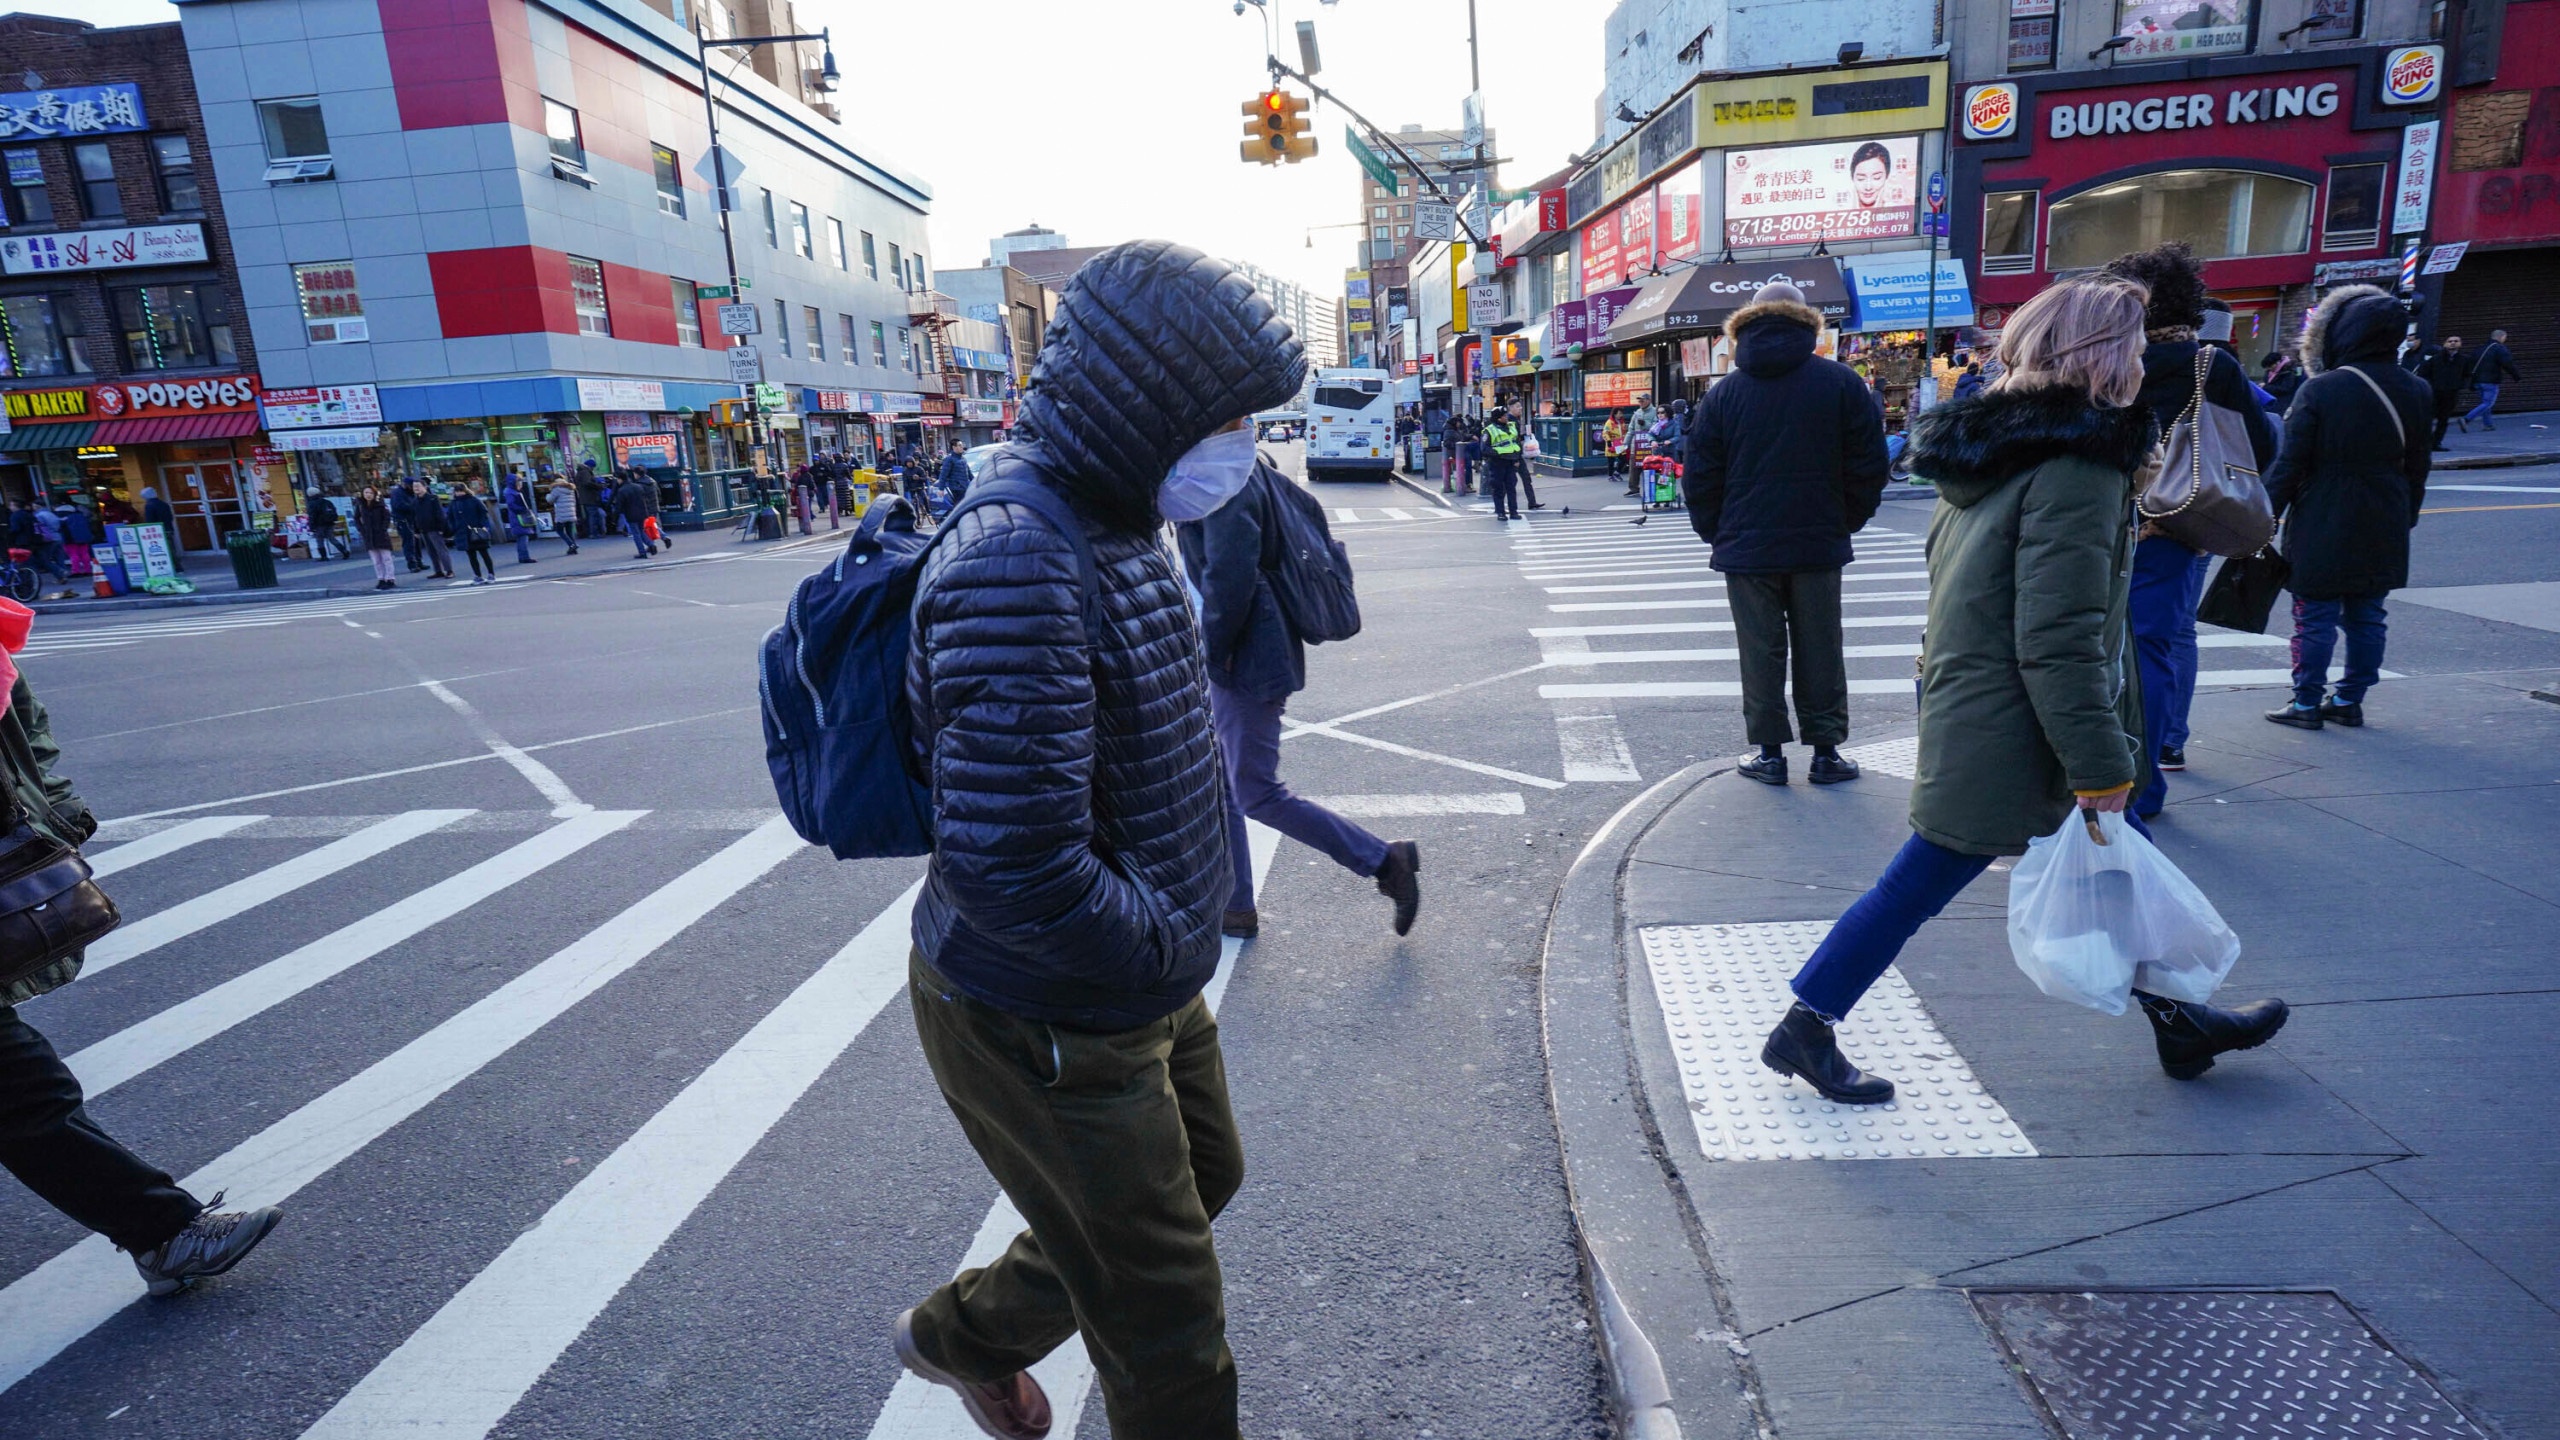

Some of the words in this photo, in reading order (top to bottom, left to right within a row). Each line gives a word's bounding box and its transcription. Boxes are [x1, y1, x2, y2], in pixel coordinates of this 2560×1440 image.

[2216, 32, 2243, 46] BLOCK
[2391, 55, 2434, 78] BURGER
[2392, 65, 2434, 91] KING
[1971, 93, 2009, 114] BURGER
[1972, 101, 2010, 126] KING
[2050, 93, 2214, 139] BURGER
[2226, 82, 2339, 124] KING
[1754, 169, 1814, 188] 常青医美
[1435, 206, 1454, 214] BLOCK
[1423, 213, 1434, 221] THE
[1436, 214, 1447, 222] BOX
[1739, 210, 1872, 235] 718-808-5758
[1739, 235, 1754, 245] Sky
[1756, 235, 1777, 244] View
[1779, 231, 1809, 241] Center
[704, 288, 719, 297] Main
[1478, 288, 1493, 298] NO
[1472, 298, 1500, 309] TURNS
[1868, 297, 1913, 308] SILVER
[1822, 305, 1846, 315] Juice
[1668, 314, 1699, 325] 39-22
[736, 349, 750, 358] NO
[731, 359, 758, 368] TURNS
[738, 373, 755, 381] BUSES
[29, 390, 87, 416] BAKERY
[615, 435, 675, 448] INJURED?
